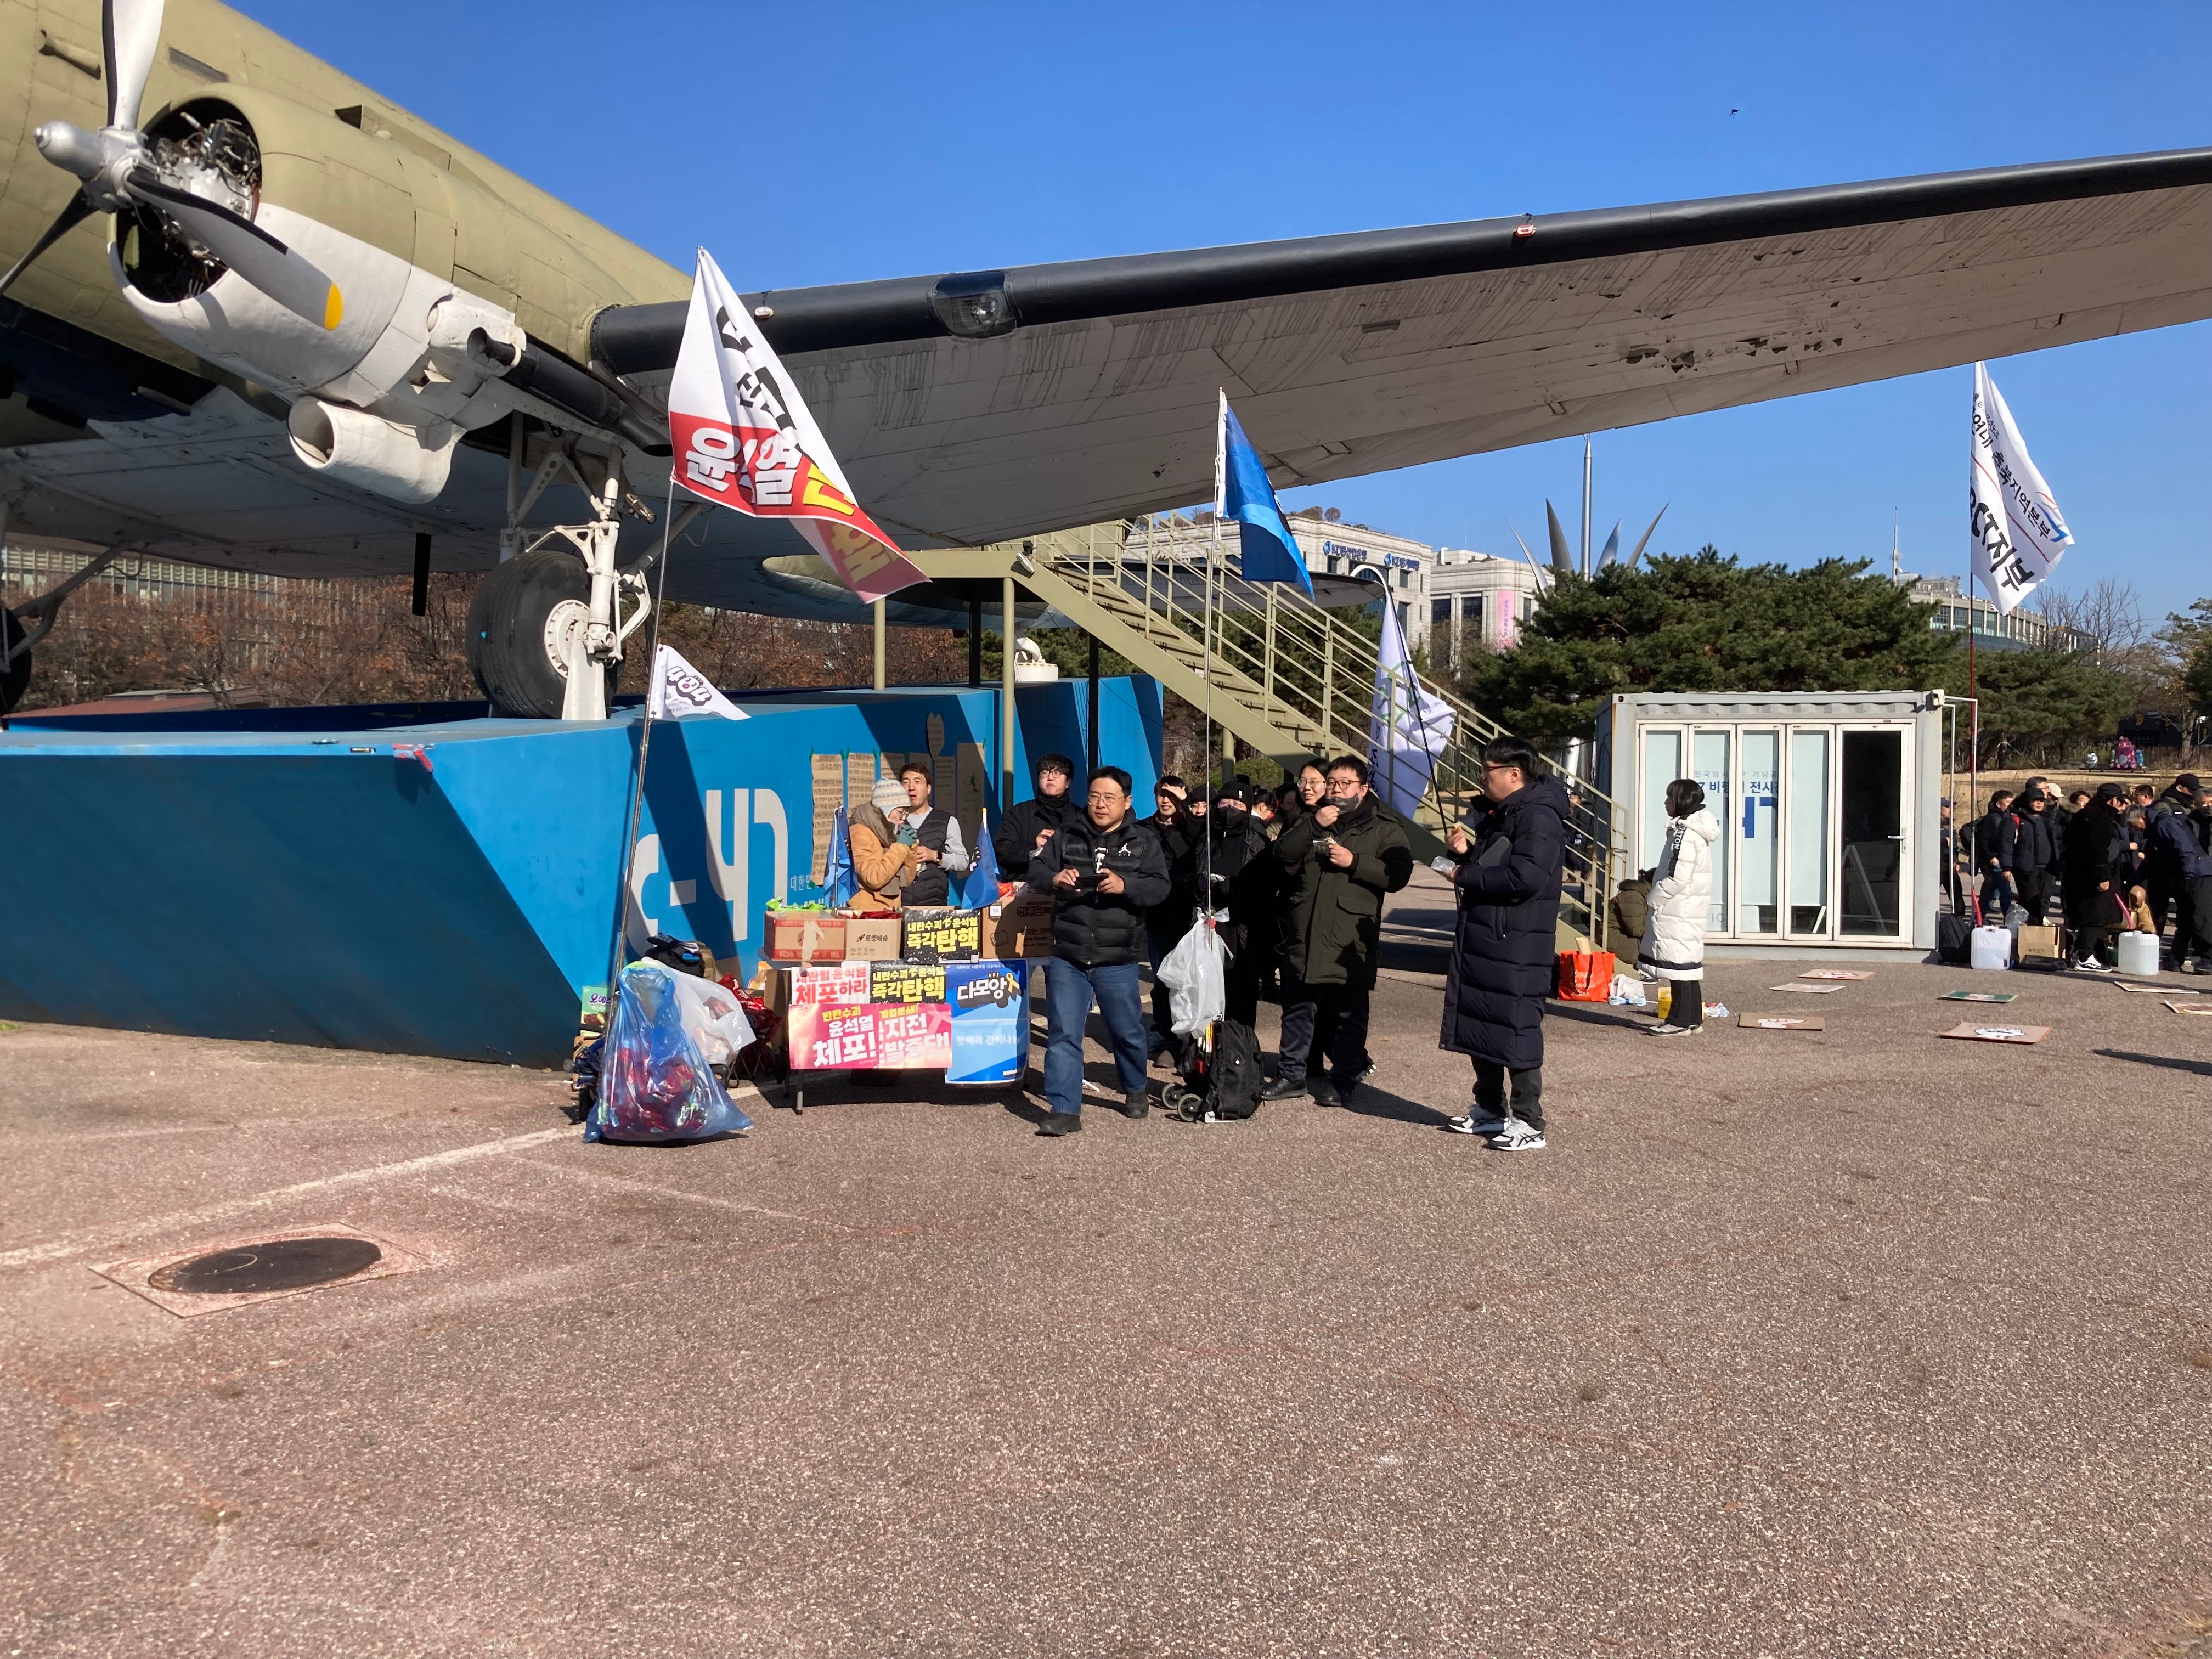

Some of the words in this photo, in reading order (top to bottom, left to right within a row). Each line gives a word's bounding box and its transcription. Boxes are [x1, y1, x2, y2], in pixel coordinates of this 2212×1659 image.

[907, 920, 942, 932] 내란수괴
[952, 916, 978, 928] 윤석열
[865, 934, 888, 942] 로켓배송
[833, 966, 866, 980] 윤석열
[872, 969, 908, 982] 내란수괴
[919, 966, 944, 977] 윤석열
[957, 977, 1007, 1000] 다모앙
[822, 1005, 861, 1022] 반란수괴
[829, 1014, 874, 1037] 윤석열
[812, 1031, 877, 1068] 체포!
